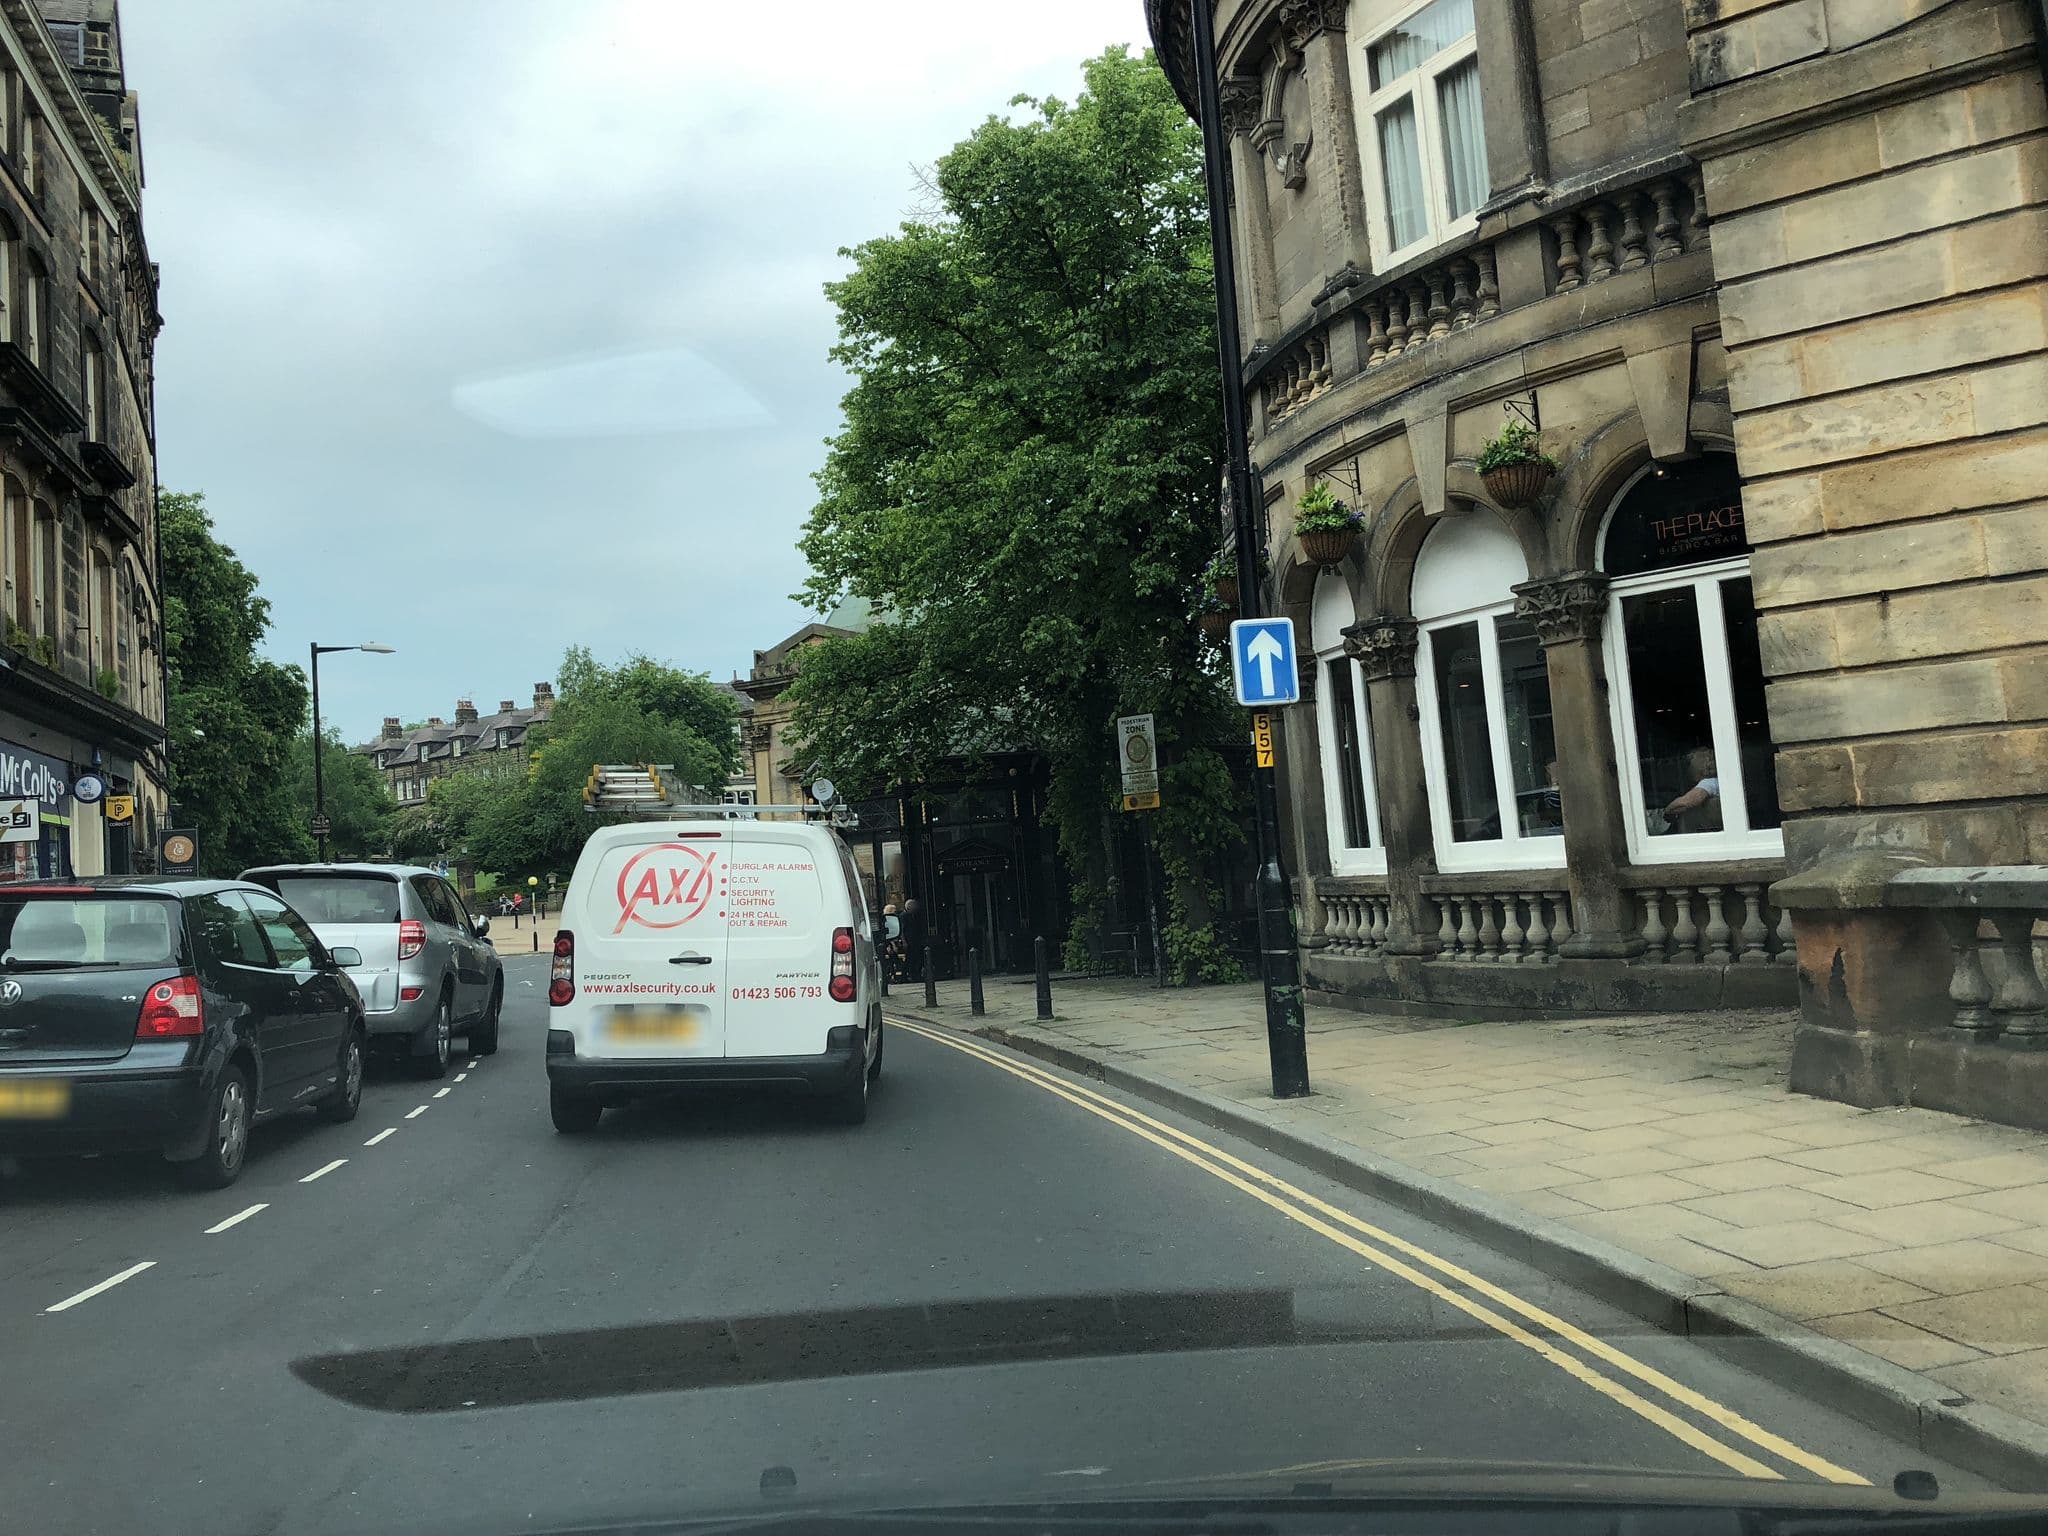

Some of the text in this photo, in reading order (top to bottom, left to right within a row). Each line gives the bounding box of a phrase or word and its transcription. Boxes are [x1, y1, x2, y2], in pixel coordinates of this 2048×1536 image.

[1125, 724, 1146, 734] ZONE
[731, 863, 814, 871] BURGLAR ALARMS
[612, 851, 717, 934] AXL
[730, 889, 775, 897] SECURITY
[730, 898, 775, 906] LIGHTING
[730, 911, 780, 919] 24 HR CALL
[729, 919, 788, 927] OUT & REPAIR
[583, 982, 716, 996] www.axlsecurity.co.uk
[732, 986, 822, 999] 01423 506 793
